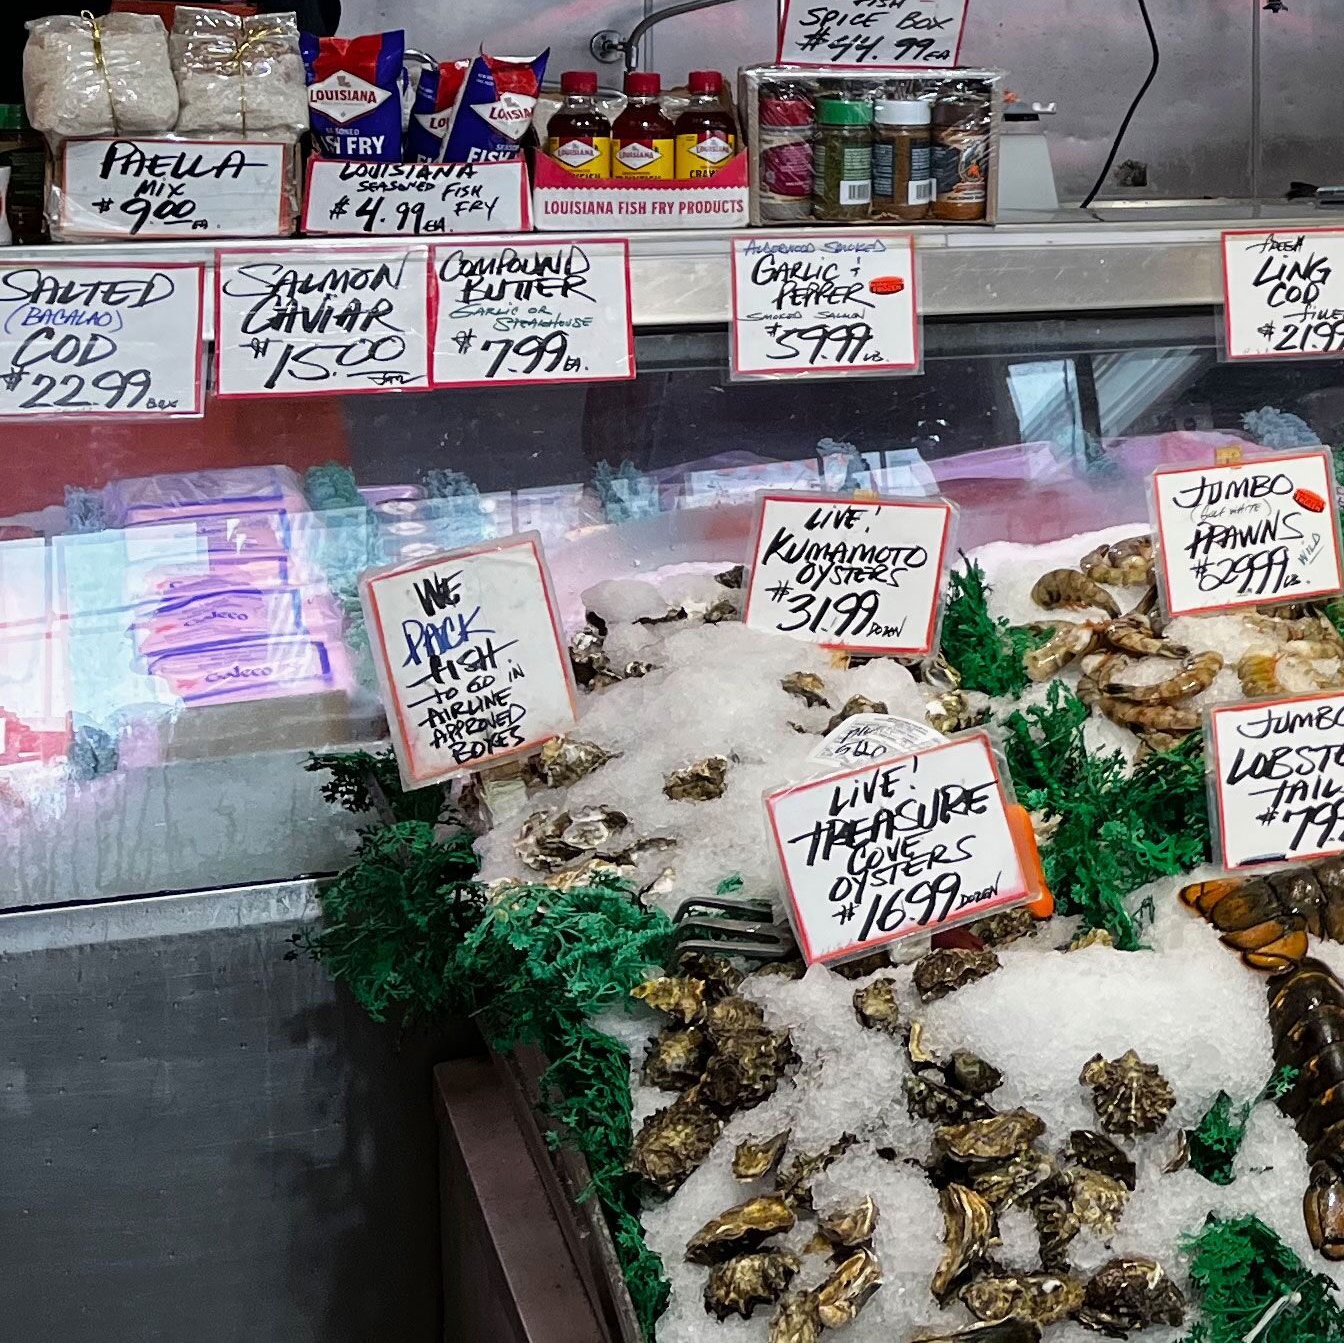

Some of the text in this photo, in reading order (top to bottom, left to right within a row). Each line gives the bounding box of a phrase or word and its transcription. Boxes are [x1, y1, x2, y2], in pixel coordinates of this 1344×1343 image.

[799, 7, 953, 31] SPICE BOX
[310, 89, 377, 105] LOUISIANA
[101, 142, 268, 179] PAELLA
[347, 135, 385, 155] FRY
[339, 162, 478, 180] LOUISIANA
[356, 180, 483, 201] SEASONED FISH
[454, 197, 499, 221] FRY
[544, 198, 744, 215] LOUISIANA FISH FRY PRODUCTS
[329, 196, 425, 234] $4.99
[439, 245, 591, 282] COMPOUND
[820, 239, 887, 254] SMOKED
[223, 259, 413, 299] SALMON
[751, 253, 841, 286] GARLIC
[0, 269, 175, 308] SALTED
[455, 275, 597, 304] BUTTER
[771, 280, 876, 311] PEPPER
[1266, 282, 1321, 309] COD
[241, 292, 414, 336] CAVIAR
[449, 301, 517, 319] GARLIC
[813, 308, 866, 320] SALMON
[12, 328, 118, 368] COD
[451, 327, 570, 379] $7.99
[764, 321, 874, 365] $59.99
[1, 367, 152, 410] $22.99
[1172, 473, 1295, 508] JUMBO
[761, 530, 928, 567] KUMAMOTO
[1184, 509, 1304, 559] PRAWNS
[796, 560, 902, 588] OYSTERS
[413, 569, 464, 617] WE
[768, 579, 879, 636] $31.99
[402, 605, 496, 668] PACK
[407, 674, 496, 708] TO GO
[417, 686, 513, 729] AIRLINE
[429, 702, 527, 749] APPROVED
[448, 724, 527, 765] BOXES
[789, 780, 1000, 867] TREASURE
[828, 834, 977, 904] OYSTERS
[847, 833, 924, 874] COVE
[830, 871, 961, 944] $16.99
